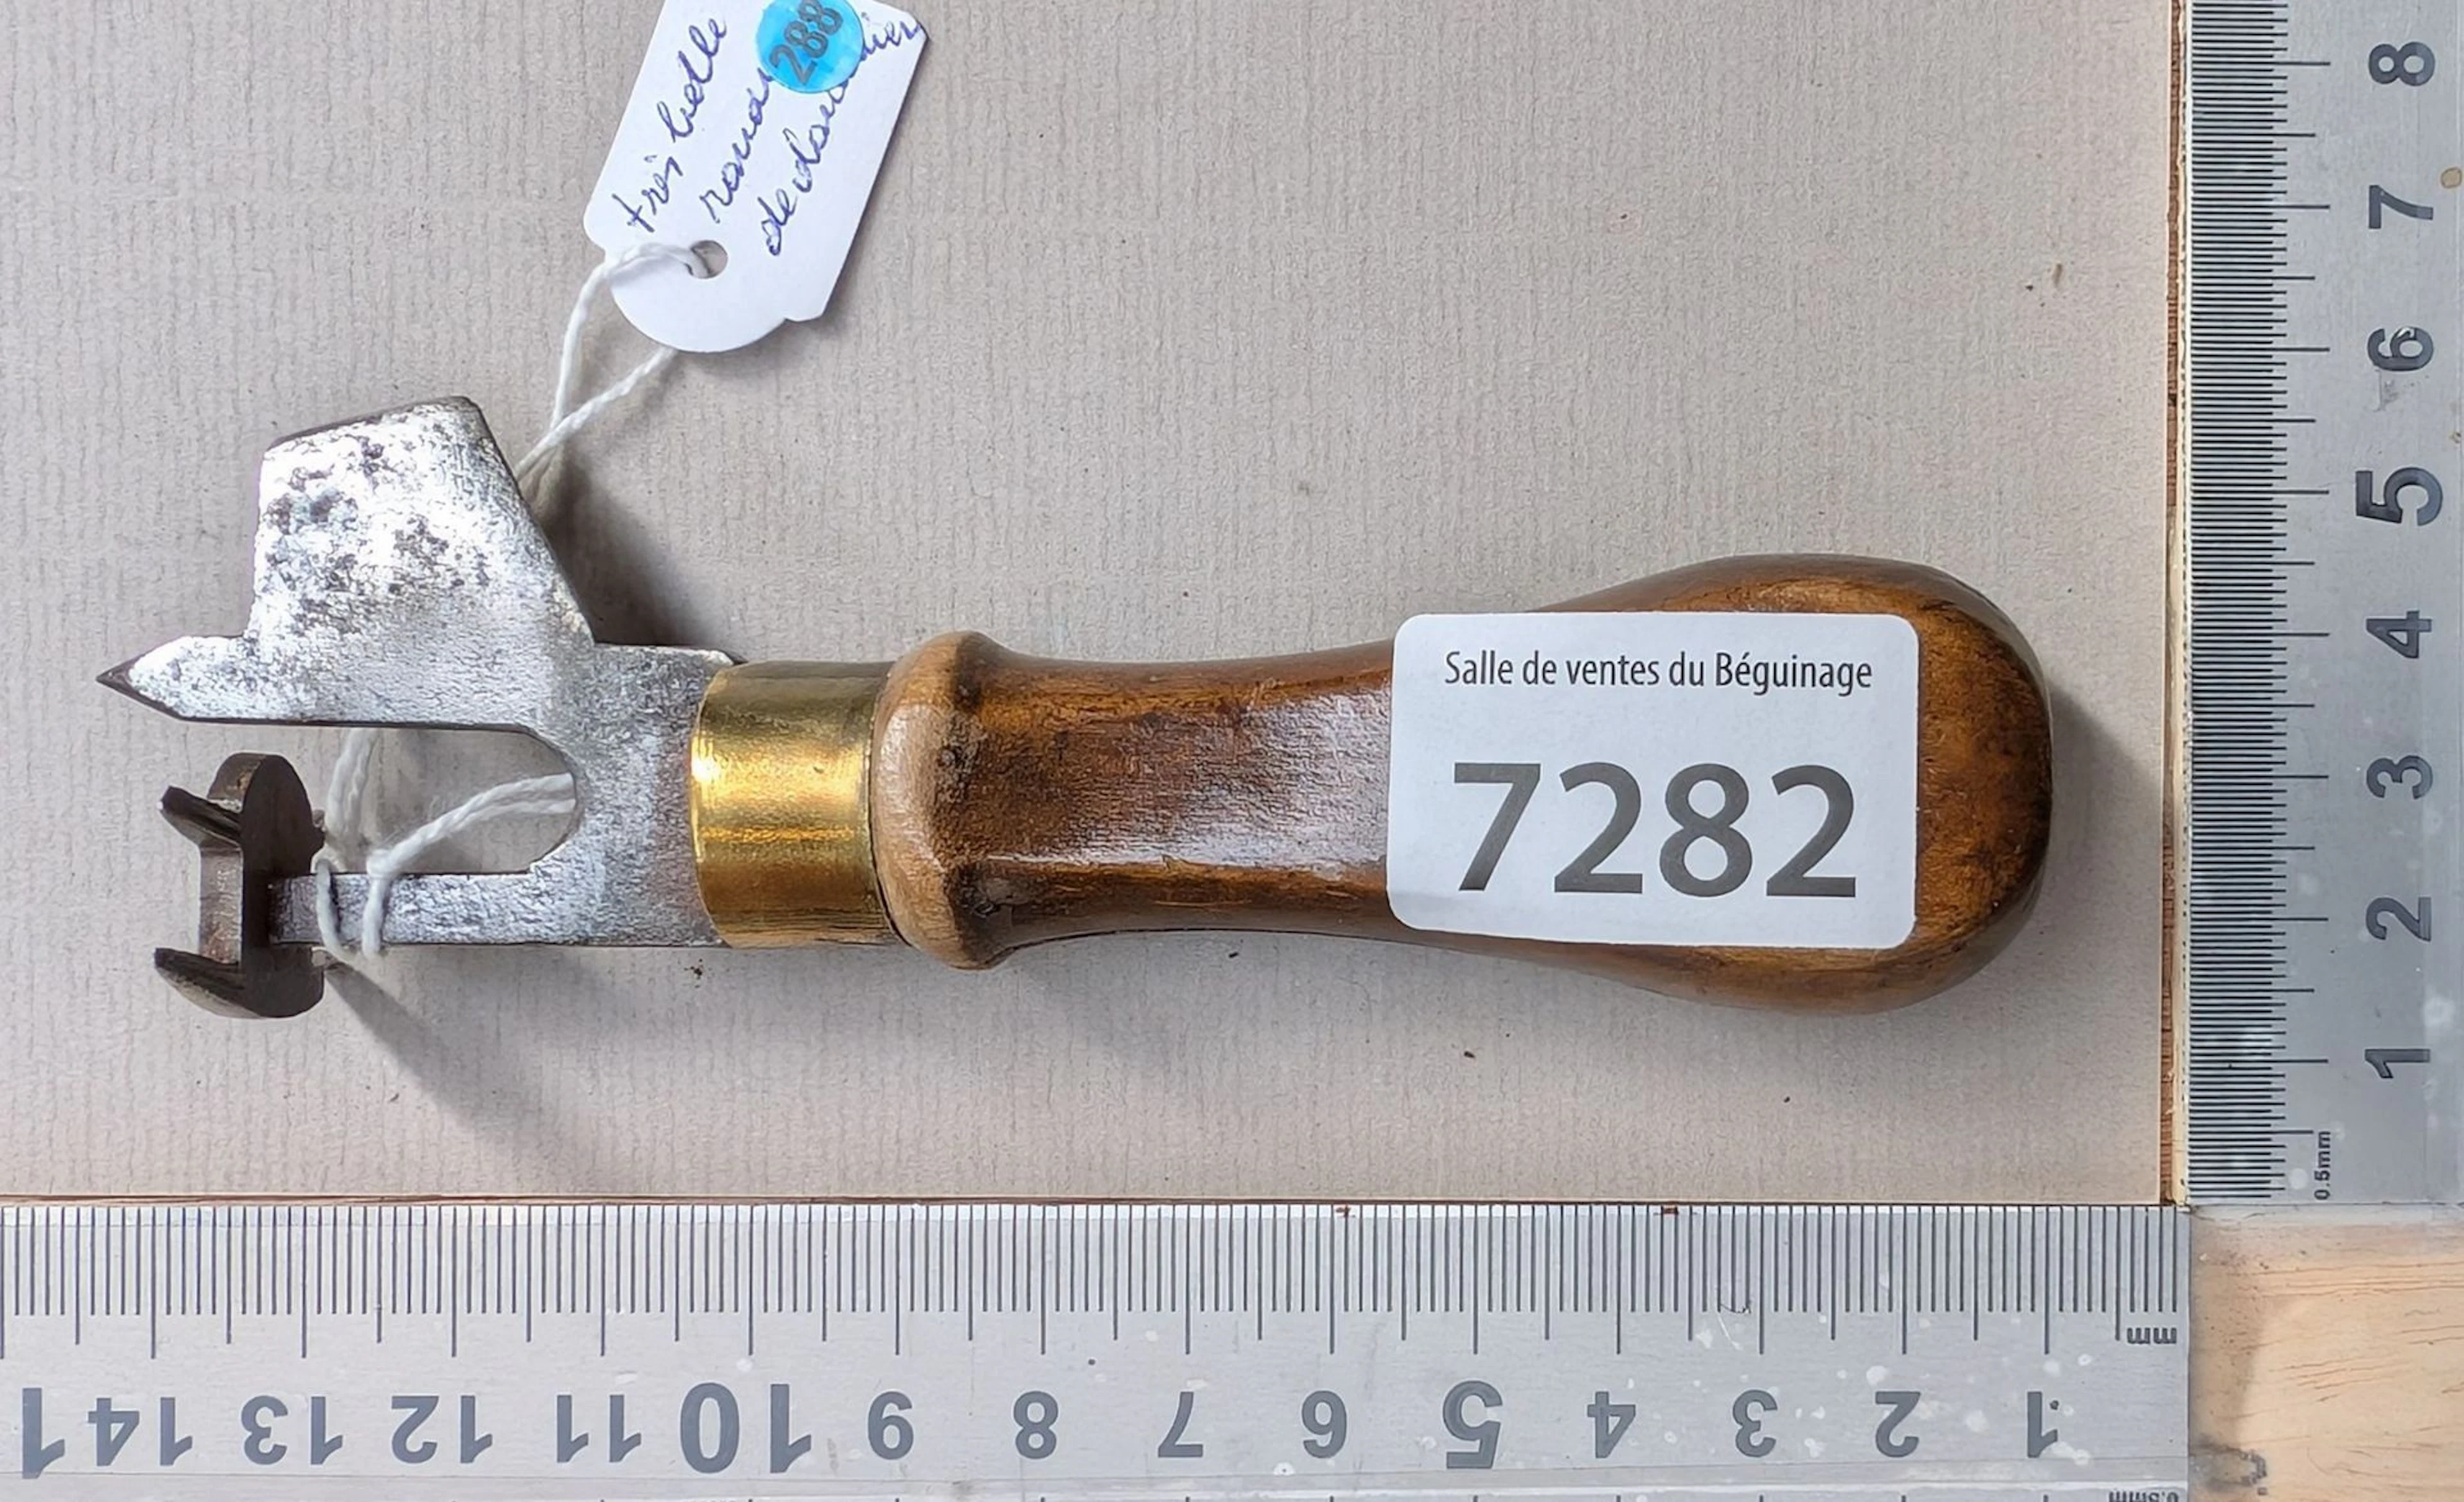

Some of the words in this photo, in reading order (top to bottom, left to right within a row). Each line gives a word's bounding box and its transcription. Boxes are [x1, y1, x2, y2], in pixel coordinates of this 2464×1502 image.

[769, 0, 843, 86] 288
[2368, 42, 2435, 86] 8
[657, 18, 728, 142] belle
[2368, 184, 2434, 229] 7
[2368, 327, 2434, 372] 6
[2355, 467, 2443, 526] 5
[2366, 610, 2433, 659] 4
[1445, 650, 1513, 685] Salle
[1523, 650, 1557, 685] de
[1566, 655, 1660, 686] ventes
[1669, 651, 1704, 687] du
[1716, 652, 1872, 697] Béguinage
[2366, 754, 2434, 800] 3
[1454, 762, 1856, 898] 7282
[2365, 897, 2432, 942] 2
[2365, 1049, 2431, 1079] 1
[2313, 1131, 2331, 1201] 0.5mm
[2126, 1327, 2177, 1345] mm
[88, 1397, 193, 1467] 14
[241, 1395, 343, 1465] 13
[391, 1395, 493, 1463] 12
[556, 1394, 642, 1463] 11
[680, 1382, 812, 1474] 10
[868, 1391, 914, 1460] 9
[1013, 1390, 1059, 1460] 8
[1158, 1391, 1204, 1458] 7
[1301, 1390, 1348, 1459] 6
[1442, 1380, 1503, 1470] 5
[1587, 1391, 1636, 1459] 4
[1732, 1389, 1778, 1458] 3
[1874, 1390, 1922, 1458] 2
[2026, 1391, 2058, 1459] 1
